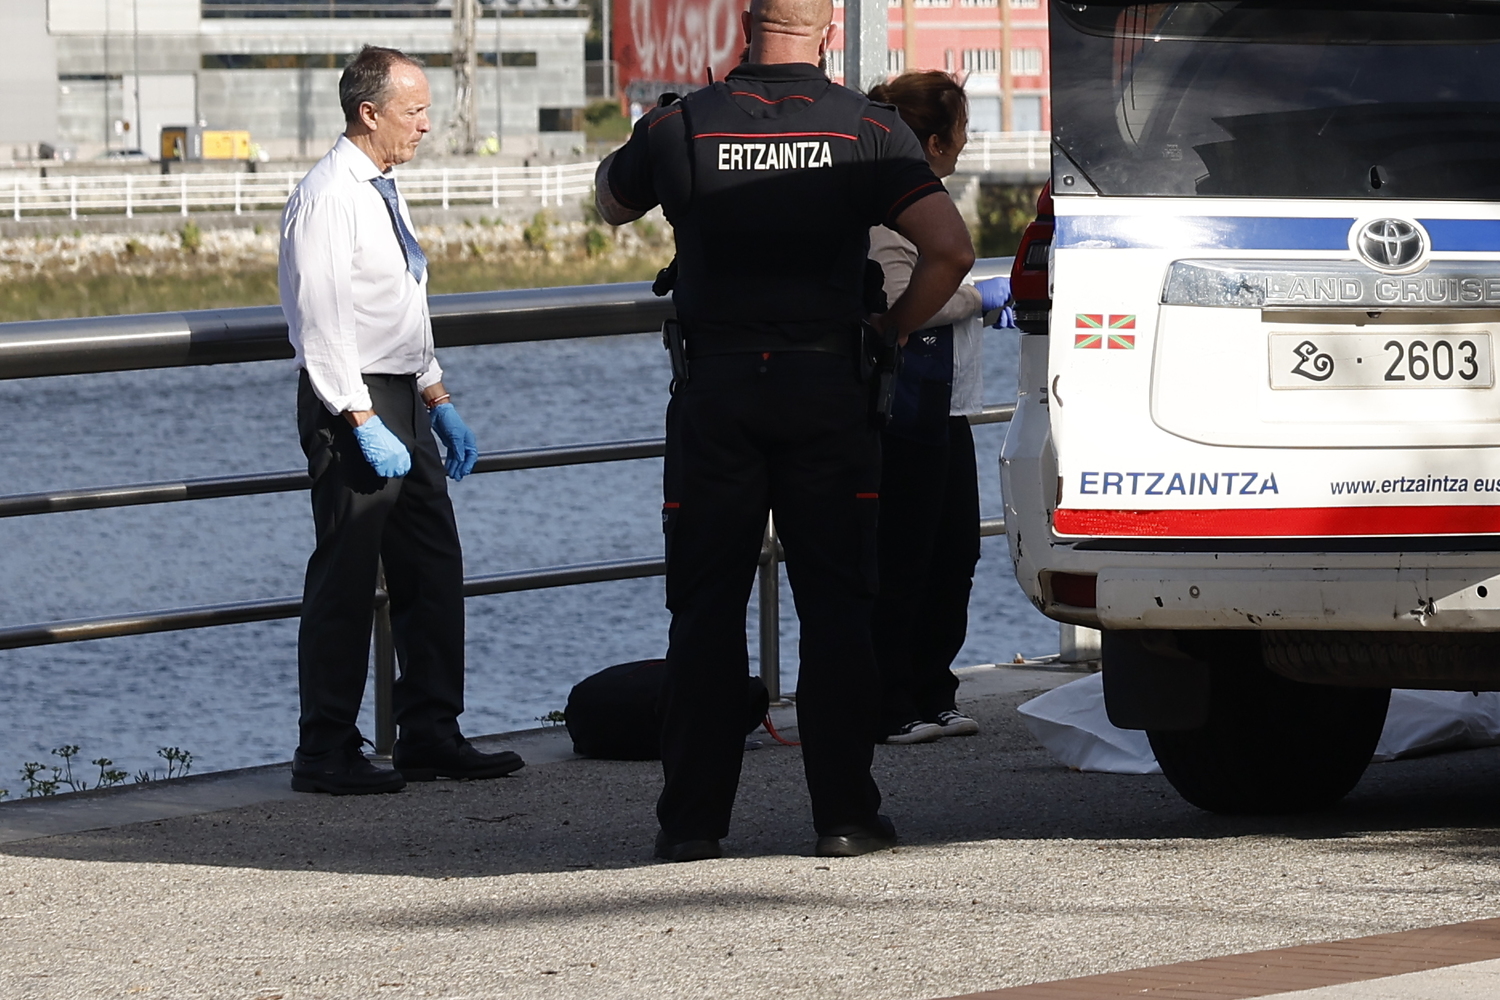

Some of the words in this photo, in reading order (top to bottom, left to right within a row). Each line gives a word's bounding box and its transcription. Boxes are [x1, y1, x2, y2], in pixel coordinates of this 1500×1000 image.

[718, 141, 832, 170] ERTZAINTZA
[1265, 278, 1363, 301] LAND
[1383, 340, 1478, 381] 2603
[1079, 471, 1280, 495] ERTZAINTZA
